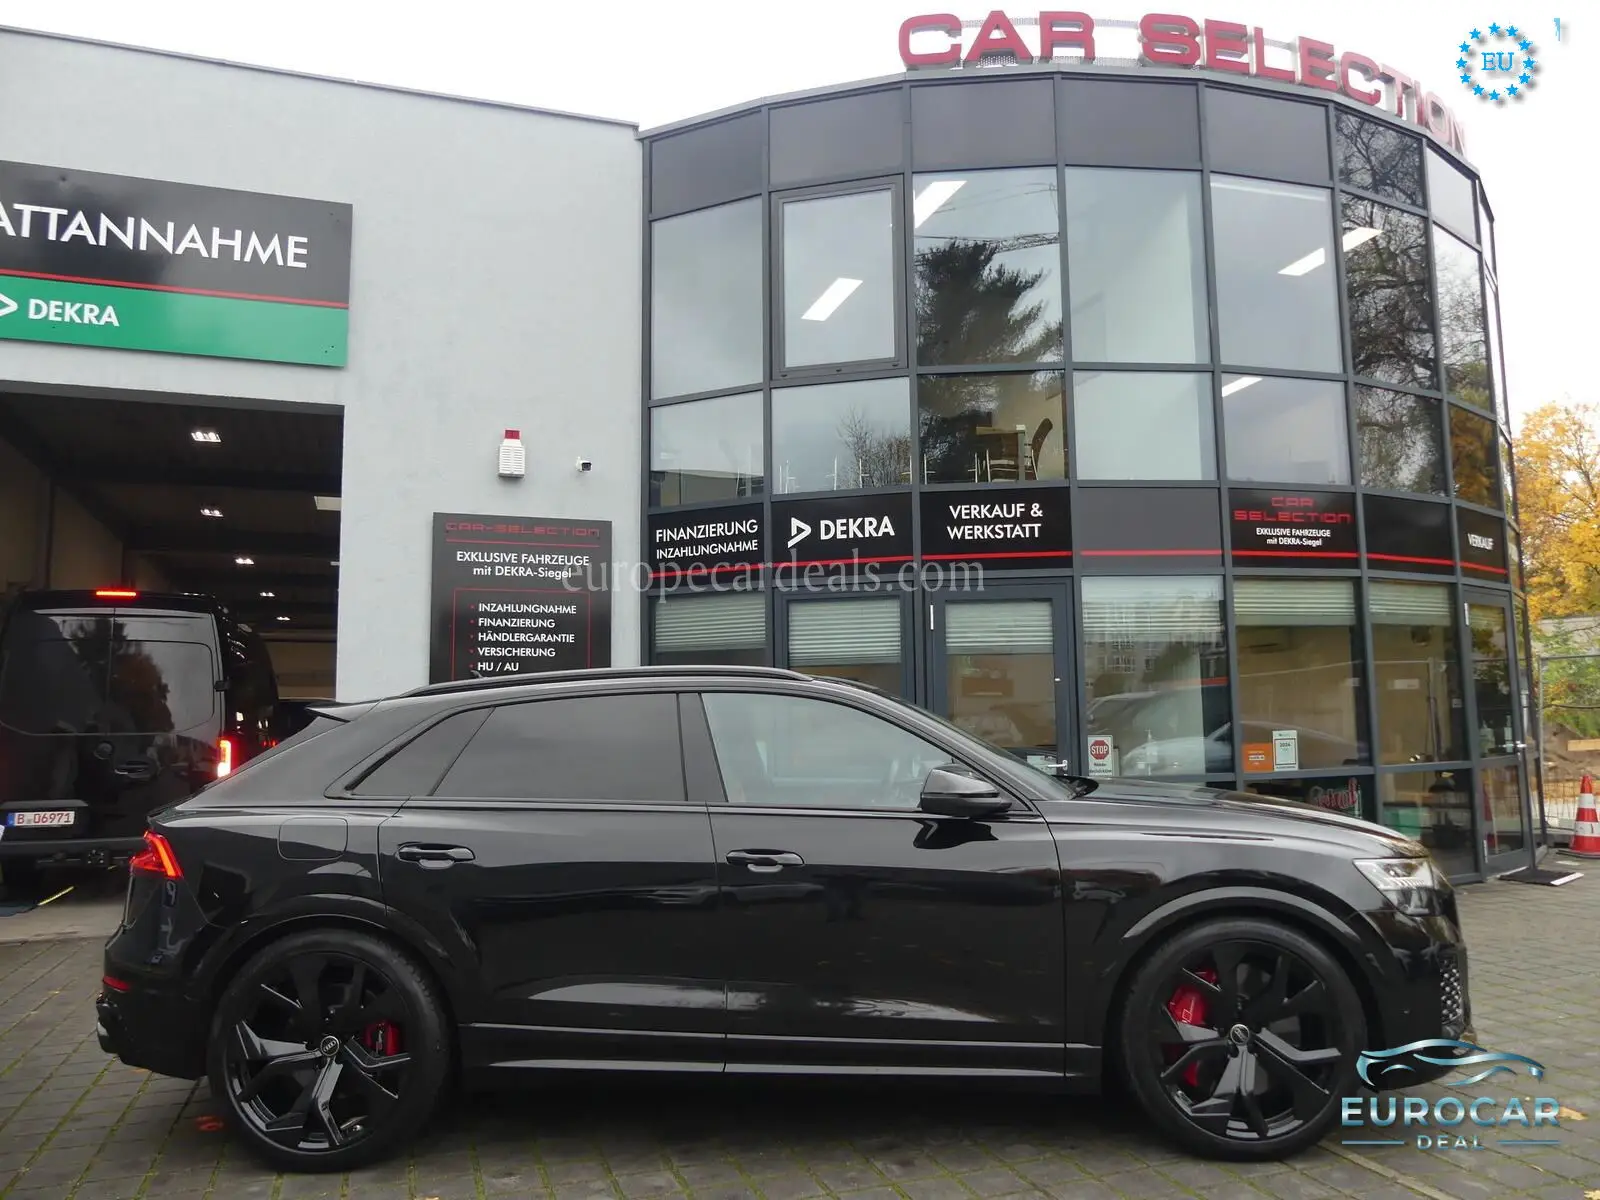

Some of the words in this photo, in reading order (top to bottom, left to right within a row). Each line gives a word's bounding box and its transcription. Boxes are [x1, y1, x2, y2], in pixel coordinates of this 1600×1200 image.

[898, 10, 1096, 67] CAR
[1138, 13, 1466, 157] SELECTION
[28, 298, 120, 327] DEKRA
[1271, 496, 1314, 507] CAR
[949, 503, 1026, 519] VERKAUF
[1030, 503, 1044, 517] &
[1233, 510, 1352, 524] SELECTION
[445, 522, 600, 537] CAR-SELECTION
[655, 519, 759, 542] FINANZIERUNG
[820, 515, 896, 541] DEKRA
[946, 523, 1042, 540] WERKSTATT
[1256, 527, 1291, 536] EXKLUSIVE
[1291, 528, 1331, 538] FAHRZEUGE
[1266, 537, 1278, 545] mit
[1278, 537, 1323, 547] DEKRA-Siegel
[656, 539, 759, 560] INZAHLUNGNAHME
[456, 551, 518, 563] EXKLUSIVE
[521, 553, 590, 566] FAHRZEUGE
[473, 565, 492, 576] mit
[495, 566, 572, 580] DEKRA-Siegel
[478, 603, 577, 614] INZAHLUNGNAHME
[478, 618, 556, 628] FINANZIERUNG
[478, 630, 575, 643] HÄNDLERGARANTIE
[477, 647, 556, 657] VERSICHERUNG
[477, 662, 494, 671] HU
[503, 662, 519, 671] AU
[1091, 745, 1109, 755] STOP
[17, 814, 25, 824] B
[33, 812, 72, 824] 06971
